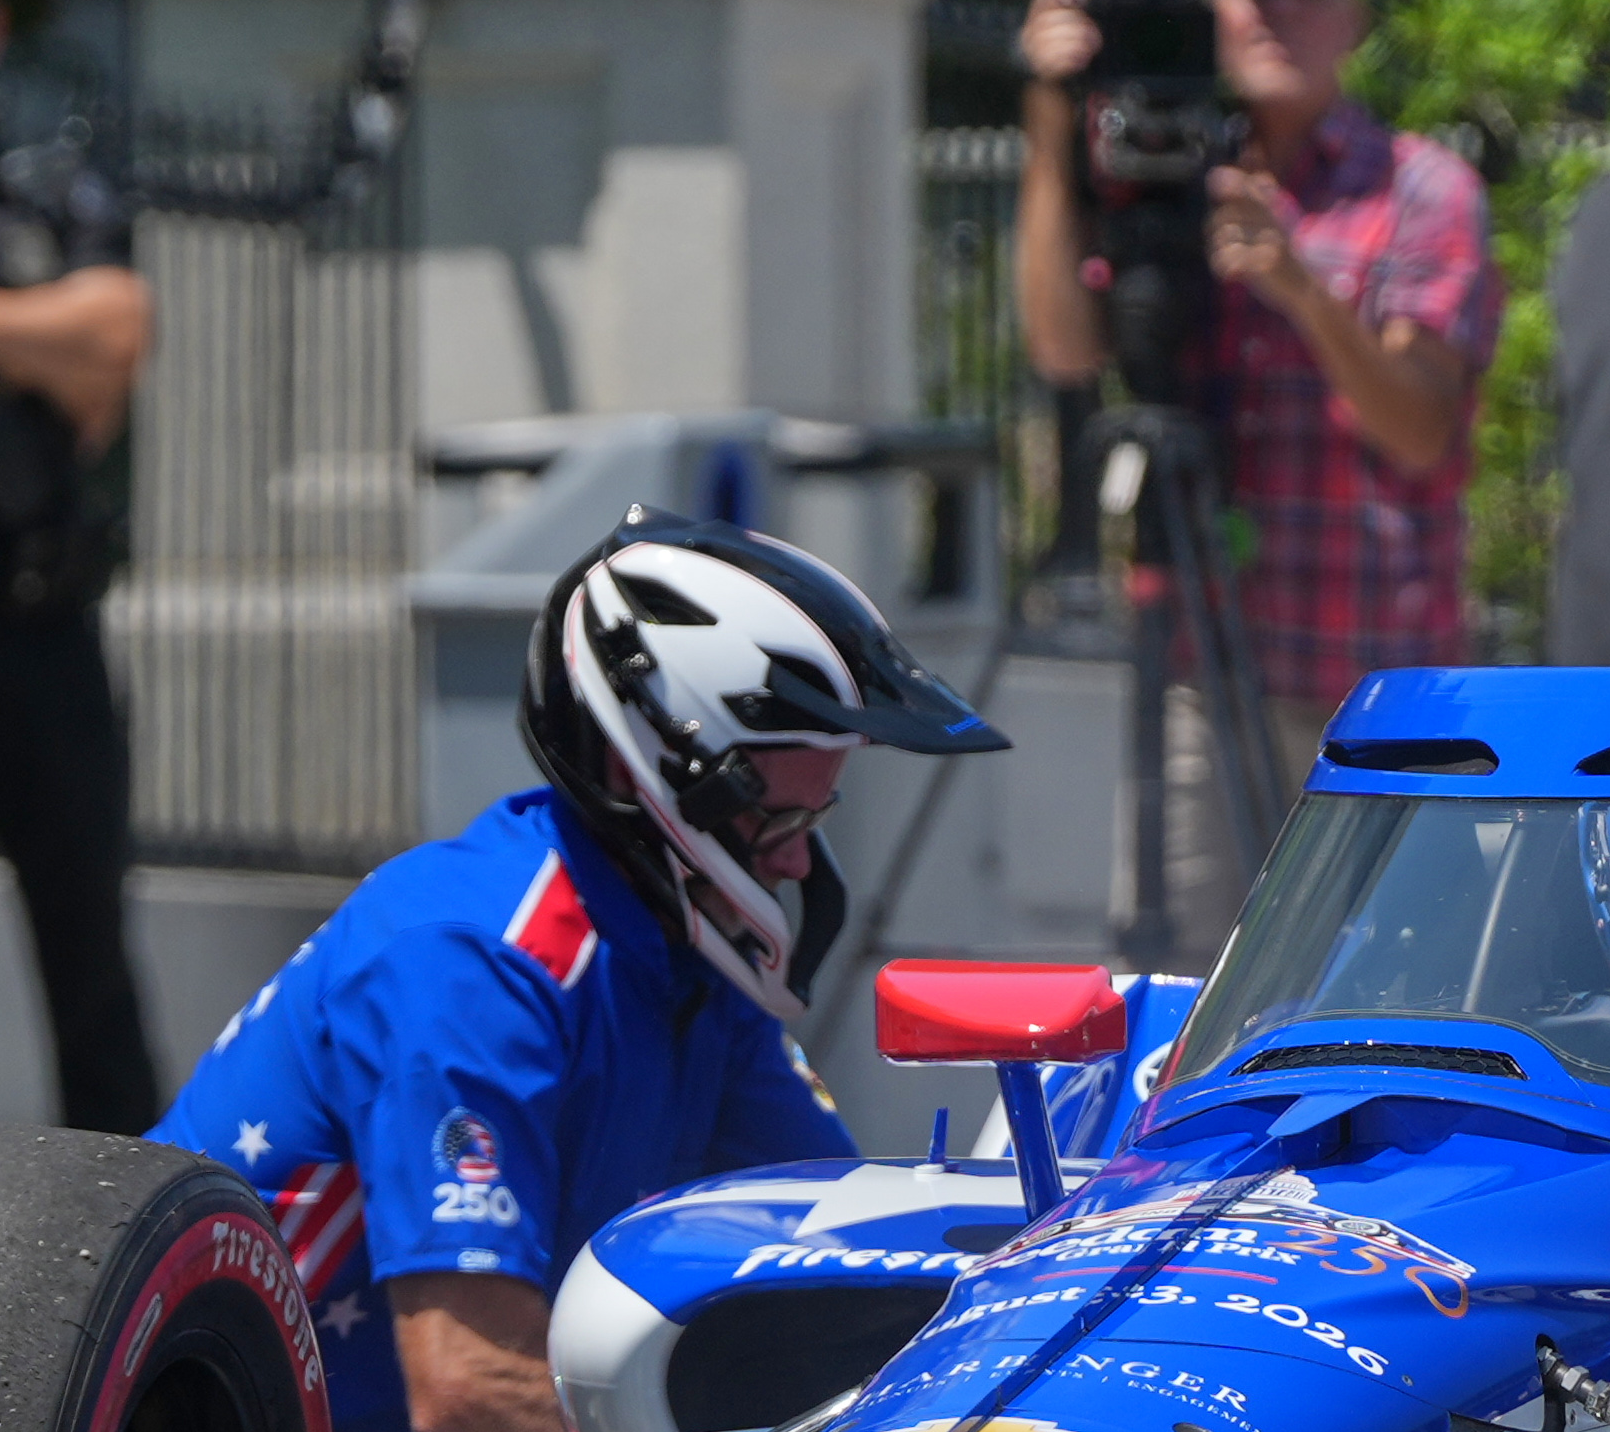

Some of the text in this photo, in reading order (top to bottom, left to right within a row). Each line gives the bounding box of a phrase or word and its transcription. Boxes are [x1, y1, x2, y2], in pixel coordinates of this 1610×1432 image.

[432, 1182, 521, 1228] 250
[733, 1242, 990, 1280] Firesto
[1204, 1240, 1302, 1266] Prix
[1265, 1230, 1470, 1319] 250
[211, 1221, 321, 1392] Firestone
[1215, 1293, 1390, 1376] 2026
[857, 1354, 1248, 1413] HARBNGER
